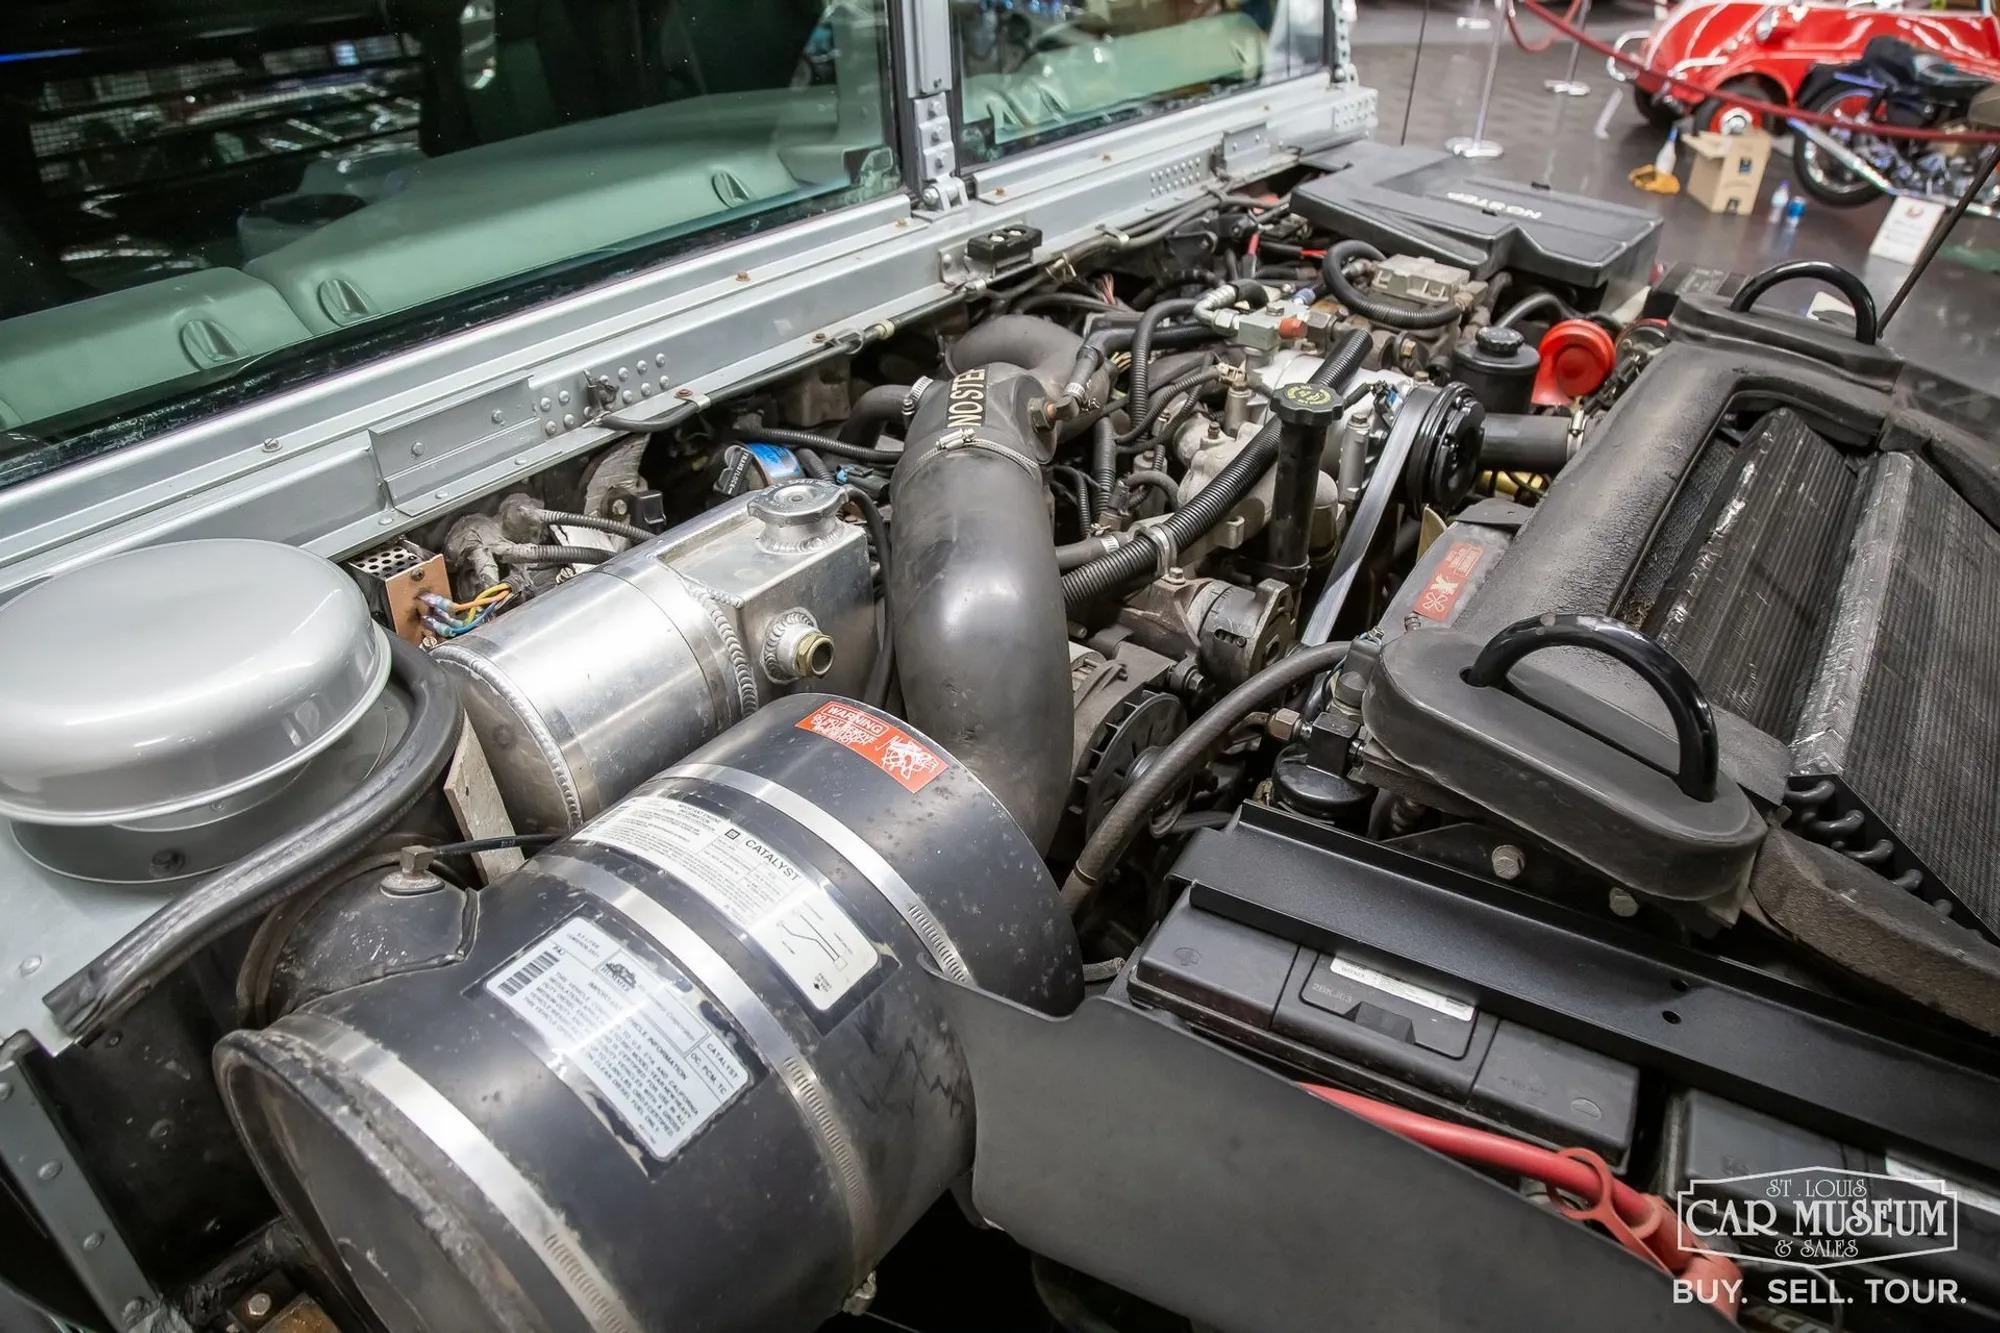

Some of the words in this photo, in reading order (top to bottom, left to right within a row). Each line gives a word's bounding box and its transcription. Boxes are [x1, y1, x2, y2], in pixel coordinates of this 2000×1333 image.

[947, 403, 983, 427] NO
[827, 706, 884, 736] WARNING
[744, 838, 800, 882] CATALYST
[647, 1036, 688, 1080] INFORMATION
[705, 1042, 739, 1079] CATALYST
[667, 1079, 699, 1116] CALIFORNIA
